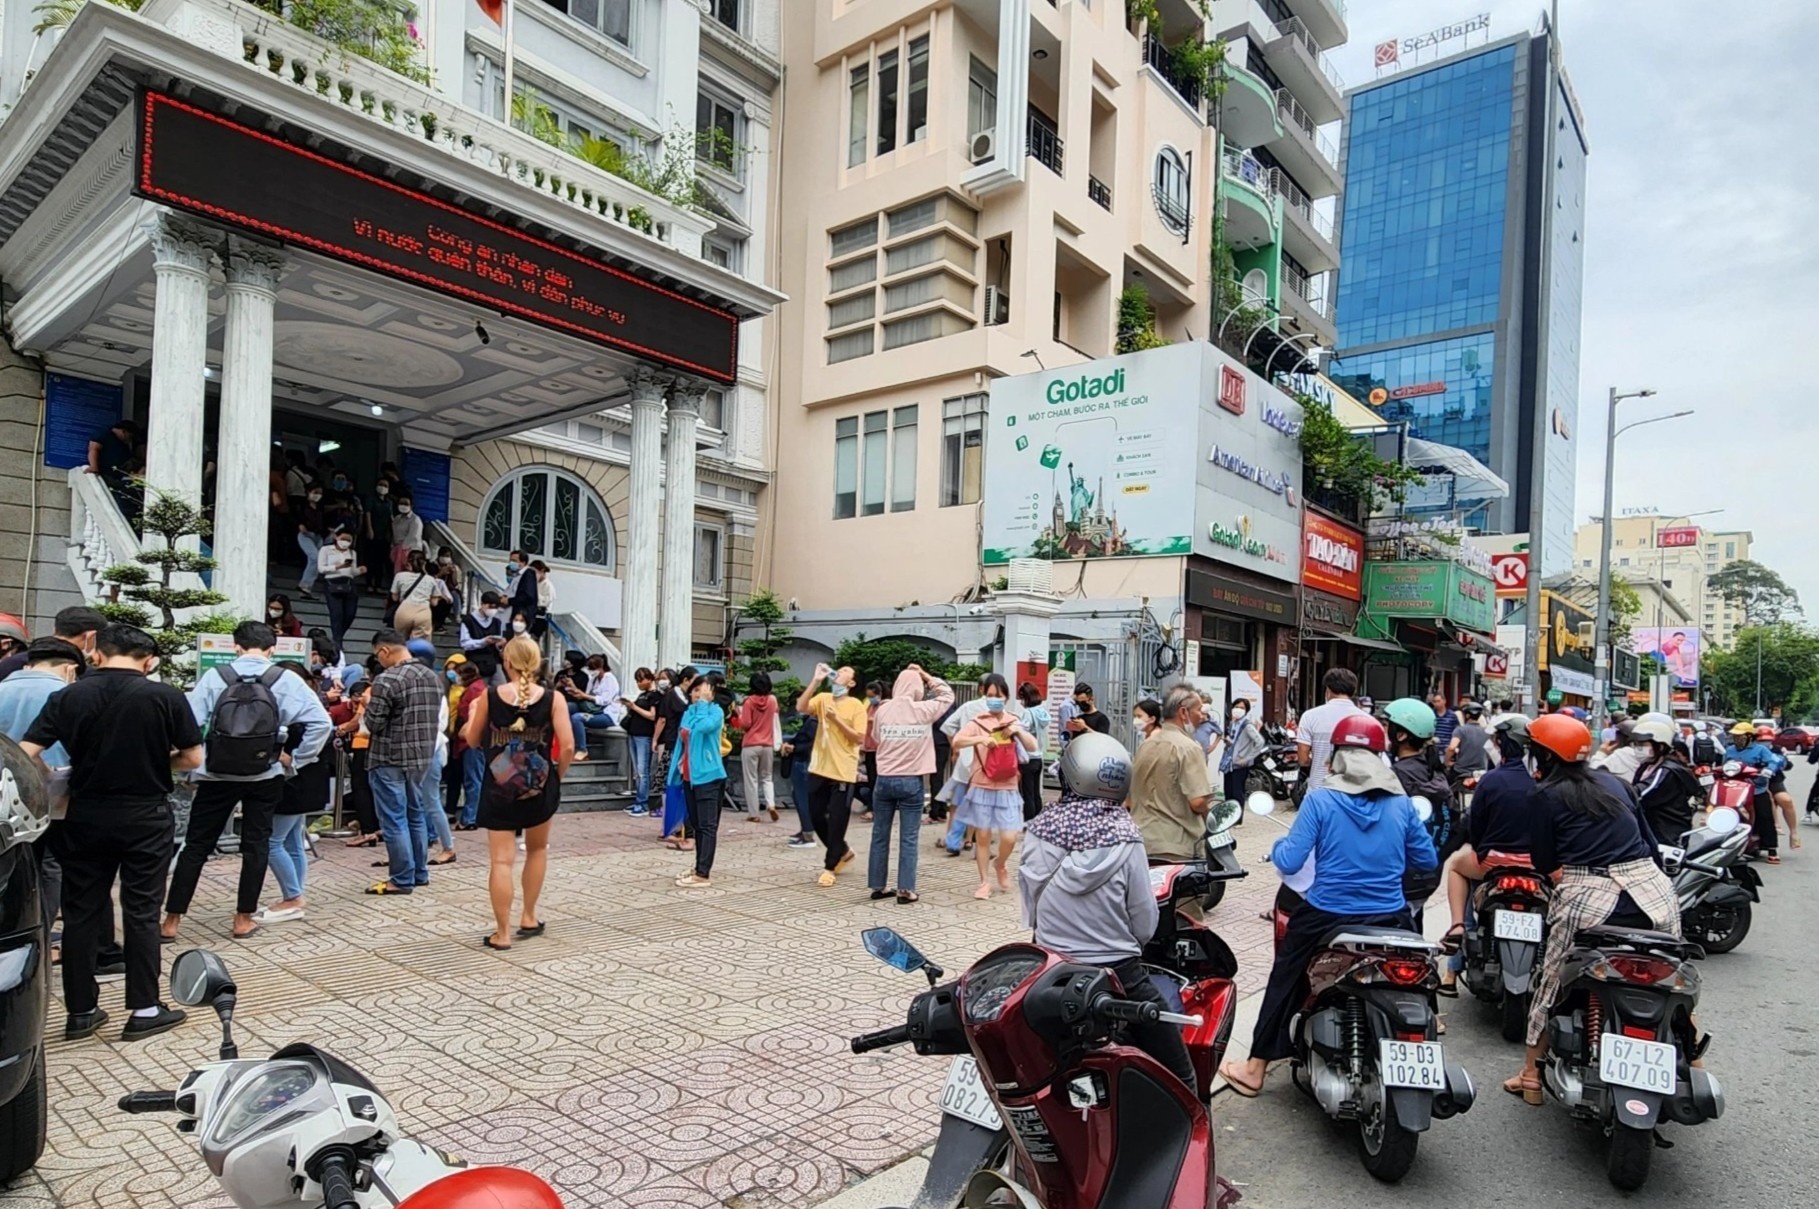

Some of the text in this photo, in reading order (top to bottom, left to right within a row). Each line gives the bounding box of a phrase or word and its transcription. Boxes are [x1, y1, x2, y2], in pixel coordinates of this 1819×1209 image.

[1402, 14, 1490, 54] SeABank
[1046, 368, 1125, 404] Gotadi
[1098, 401, 1110, 411] RA
[1622, 506, 1659, 515] ITAXA
[1376, 600, 1434, 608] PHOTOCOPY
[1502, 912, 1534, 927] 59-F2
[1498, 924, 1538, 940] 174.08
[1389, 1043, 1434, 1064] 59-D3
[1613, 1040, 1664, 1067] 67-L2
[1388, 1064, 1441, 1086] 102.84
[1606, 1059, 1670, 1089] 407.09
